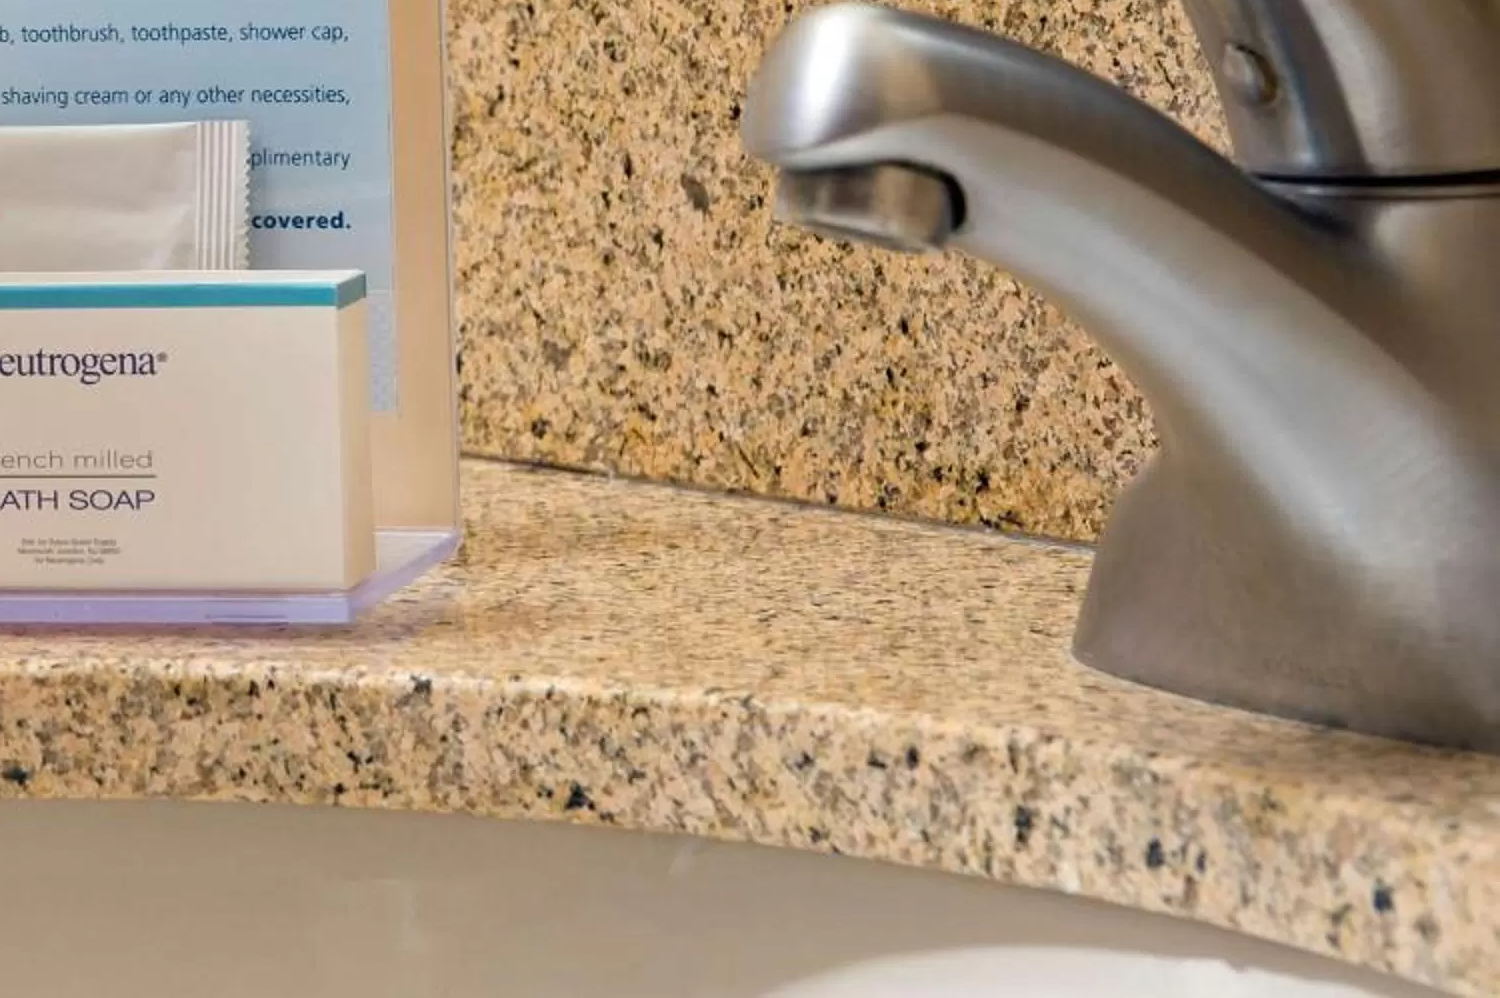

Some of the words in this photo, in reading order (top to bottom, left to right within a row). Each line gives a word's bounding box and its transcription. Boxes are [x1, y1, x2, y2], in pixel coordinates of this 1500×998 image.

[21, 23, 125, 44] toothbrush,
[131, 22, 233, 46] toothpaste,
[239, 22, 305, 42] shower
[311, 24, 349, 44] cap,
[1, 86, 69, 108] shaving
[73, 89, 129, 104] cream
[134, 88, 153, 104] or
[158, 89, 191, 107] any
[196, 84, 245, 104] other
[251, 83, 350, 106] necessities,
[251, 210, 352, 229] covered.
[73, 449, 153, 469] milled
[68, 489, 156, 511] SOAP
